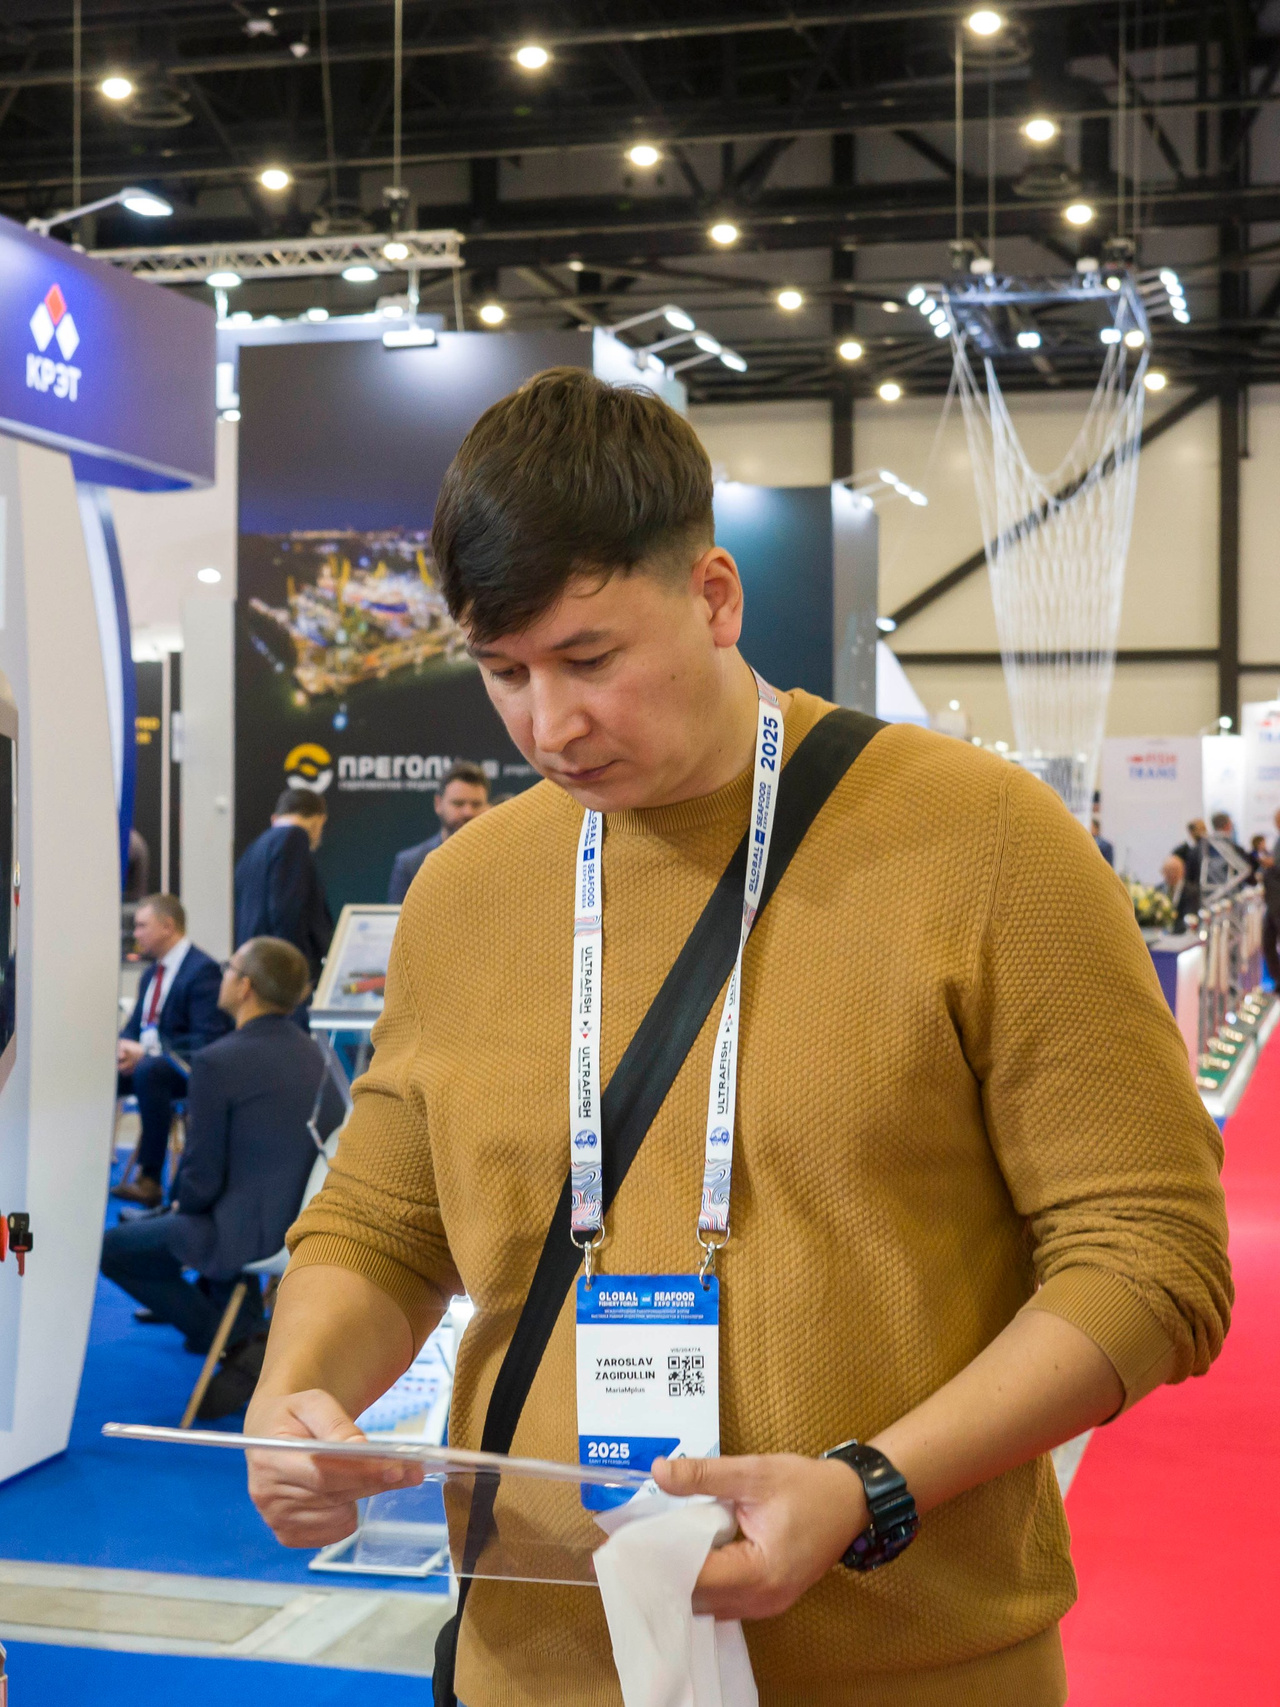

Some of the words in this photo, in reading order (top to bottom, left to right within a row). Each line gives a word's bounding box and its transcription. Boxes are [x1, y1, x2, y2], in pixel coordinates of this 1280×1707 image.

[26, 352, 82, 402] КРЭТ
[760, 715, 779, 772] 2025
[756, 781, 767, 828] SEAFOOD
[588, 810, 598, 846] LOBAL
[587, 863, 595, 908] SEAFOOD
[748, 846, 760, 892] GLOBAL
[583, 946, 593, 1014] ULTRAFISH
[581, 1046, 592, 1119] ULTRAFISH
[717, 1040, 729, 1115] ULTRAFISH
[599, 1291, 638, 1301] GLOBAL
[654, 1291, 695, 1301] SEAFOOD
[595, 1370, 656, 1380] ZAGIDULLIN
[596, 1357, 653, 1367] YAROSLAV
[587, 1441, 630, 1459] 2025
